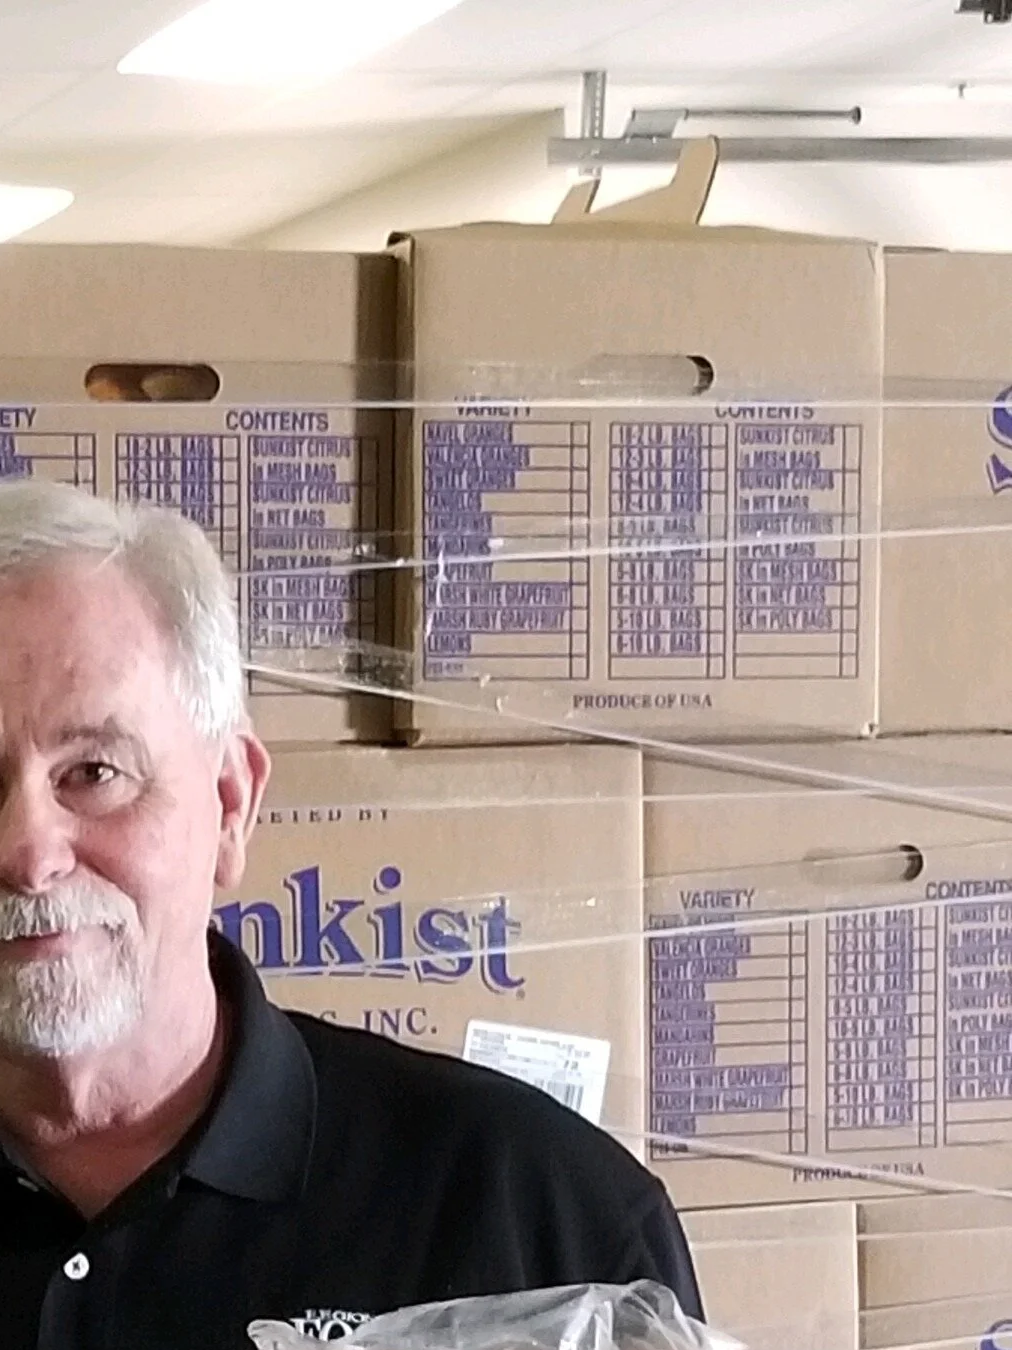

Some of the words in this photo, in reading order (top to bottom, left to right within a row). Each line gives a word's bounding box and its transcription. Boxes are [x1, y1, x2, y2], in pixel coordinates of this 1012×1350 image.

[226, 411, 329, 431] CONTENTS
[573, 695, 652, 710] PRODUCE
[653, 694, 678, 709] OF
[679, 693, 712, 709] USA
[679, 888, 756, 909] VARIETY
[210, 866, 526, 998] nkist
[364, 1007, 438, 1038] INC.
